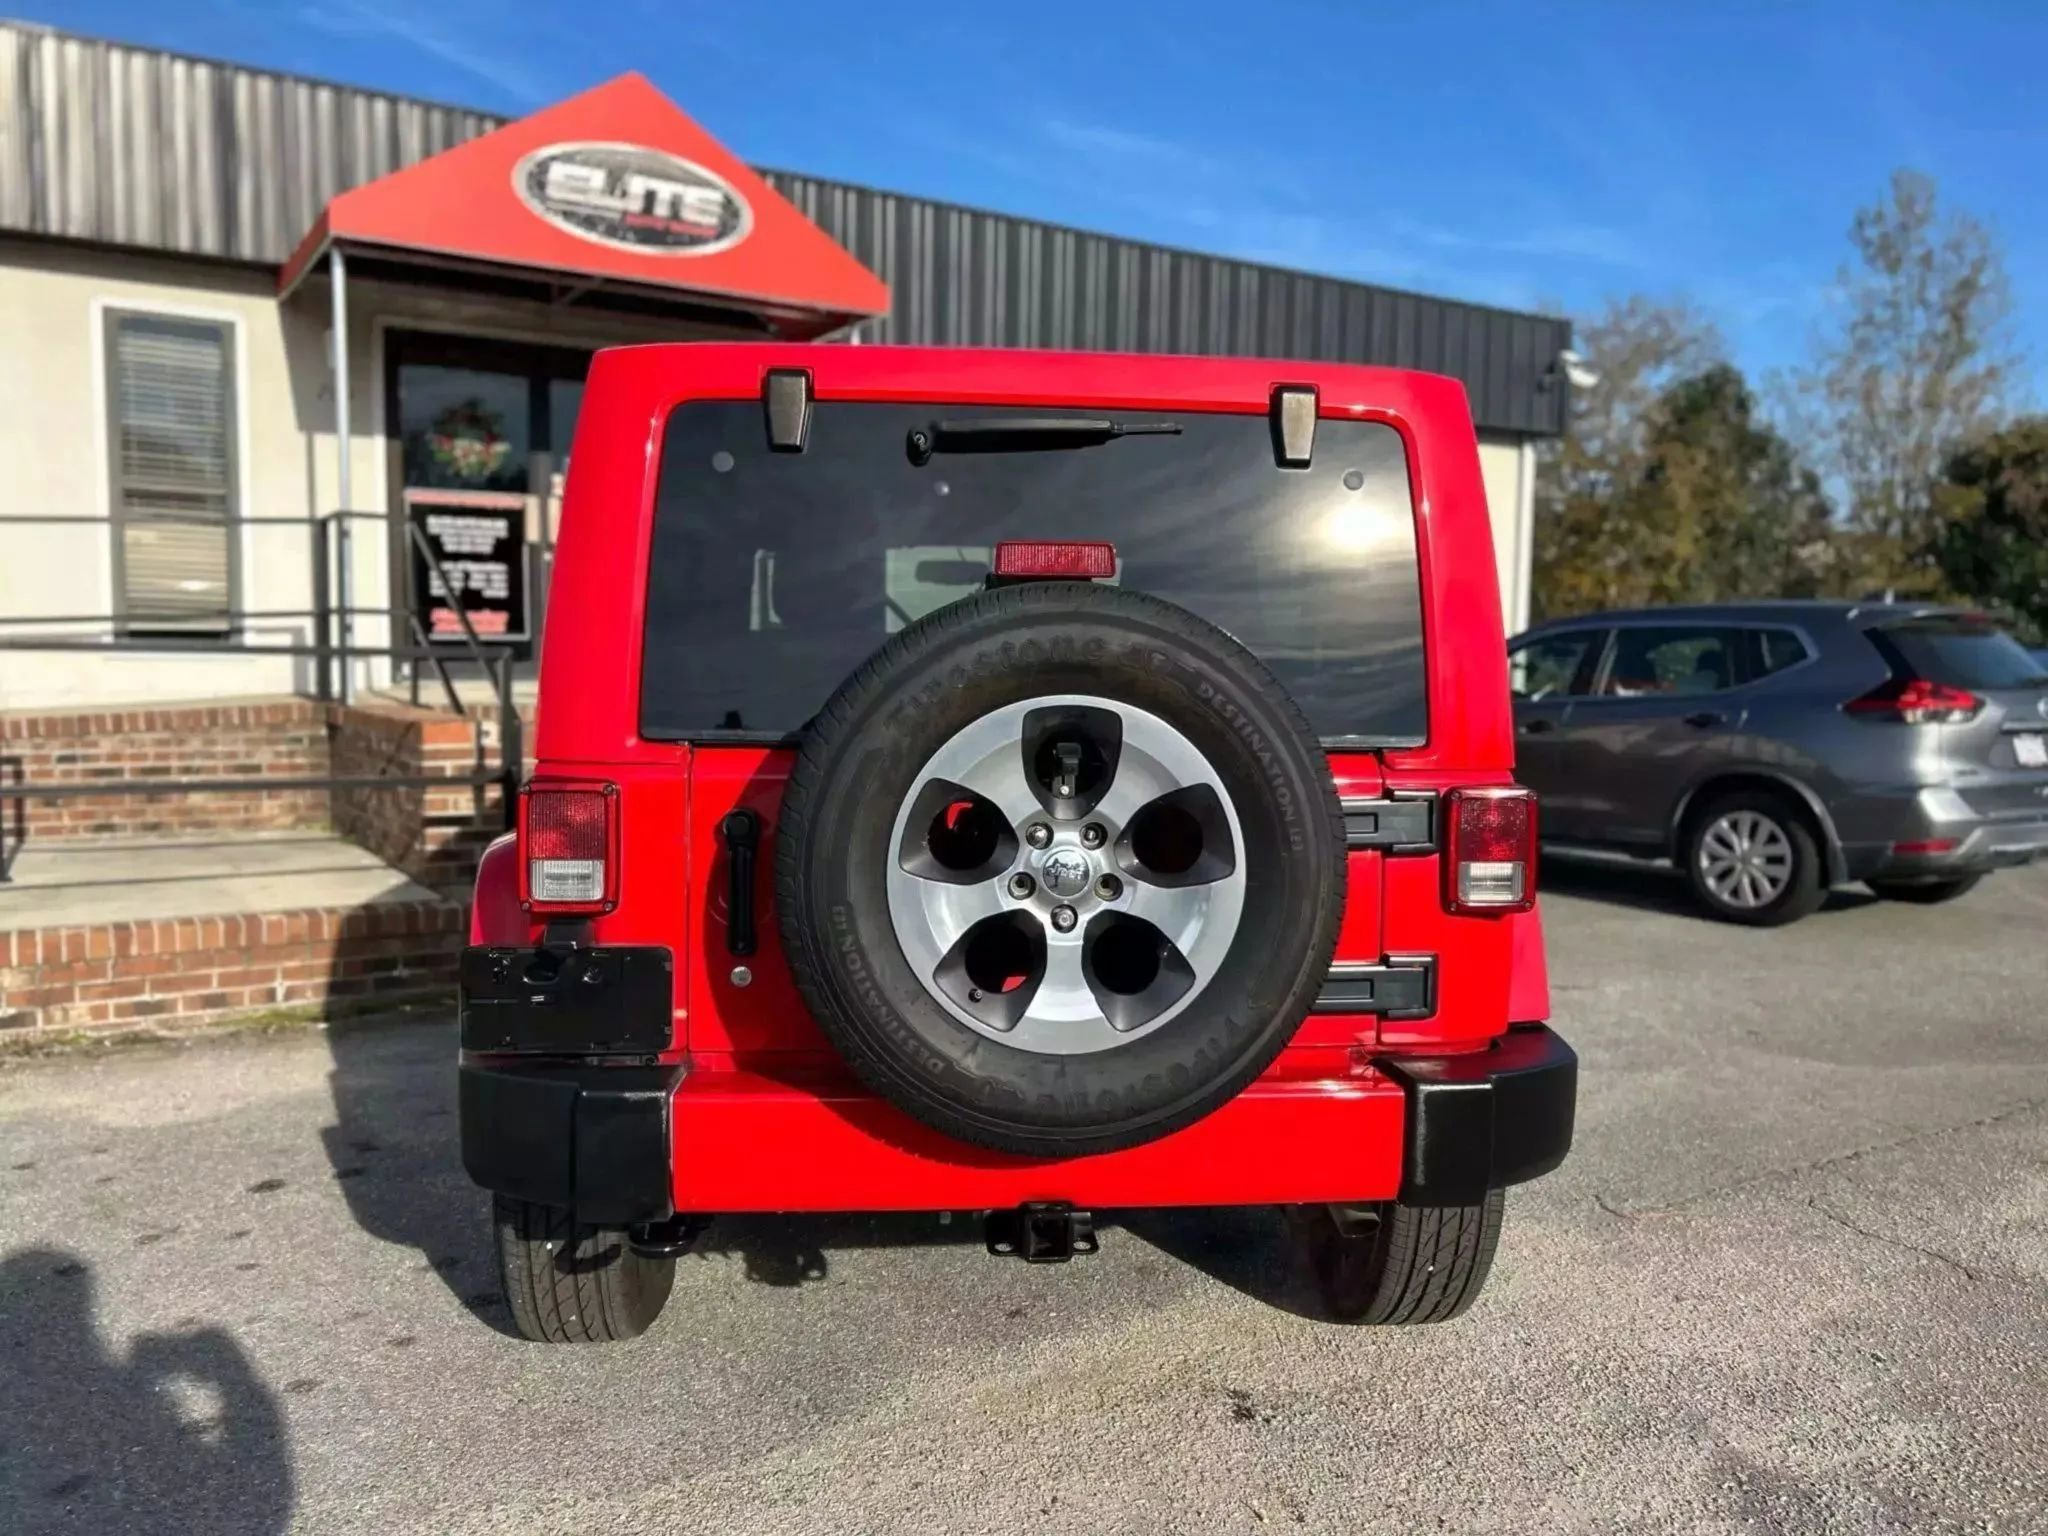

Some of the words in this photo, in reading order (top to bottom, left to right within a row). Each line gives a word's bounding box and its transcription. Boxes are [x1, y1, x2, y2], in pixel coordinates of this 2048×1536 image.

[545, 160, 724, 226] ELITE
[1199, 681, 1297, 822] DESTINATION
[838, 934, 946, 1074] DESTINATION
